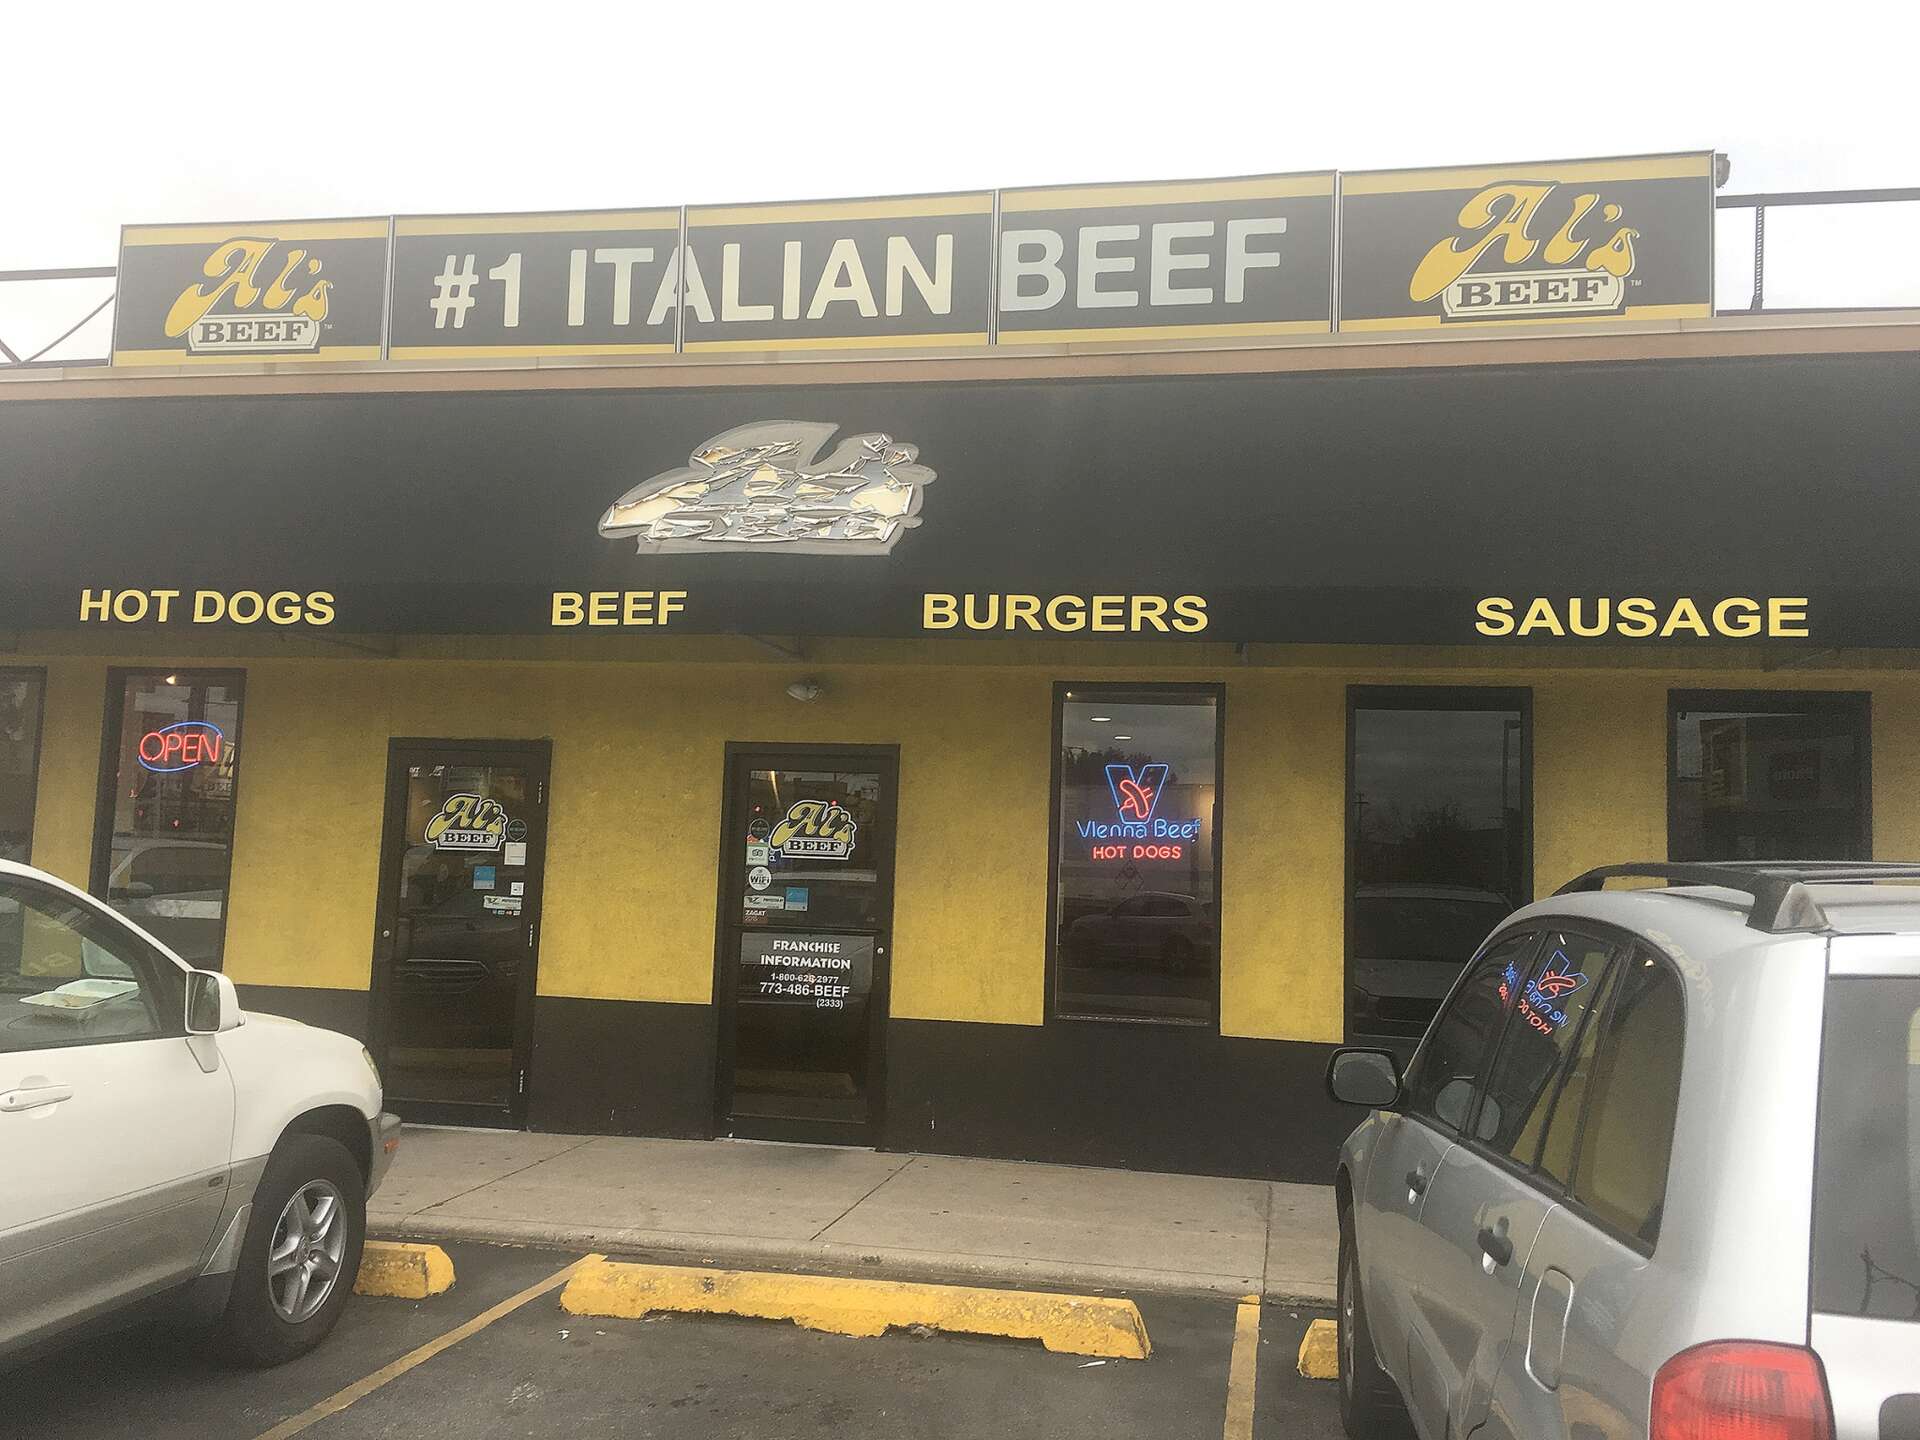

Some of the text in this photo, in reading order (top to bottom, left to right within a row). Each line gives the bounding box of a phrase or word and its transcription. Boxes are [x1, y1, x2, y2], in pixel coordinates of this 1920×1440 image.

[1410, 184, 1639, 302] Al's
[165, 238, 333, 337] Al's
[429, 218, 1287, 329] #1 ITALIAN BEEF
[1456, 277, 1608, 308] BEEF
[198, 319, 308, 345] BEEF
[79, 589, 335, 626] HOT DOGS
[551, 591, 688, 626] BEEF
[923, 593, 1209, 632] BURGERS
[1475, 597, 1809, 637] SAUSAGE
[139, 731, 222, 763] OPEN
[426, 795, 506, 840] Al's
[771, 802, 856, 847] Al's
[1154, 818, 1202, 838] Beef
[443, 832, 494, 844] BEEF
[788, 840, 842, 852] BEEF
[1092, 845, 1182, 860] HOT DOGS
[760, 954, 851, 970] INFORMATION
[773, 940, 841, 954] FRANCHISE
[760, 982, 850, 998] 773-486-BEEF
[816, 998, 844, 1010] (2333)
